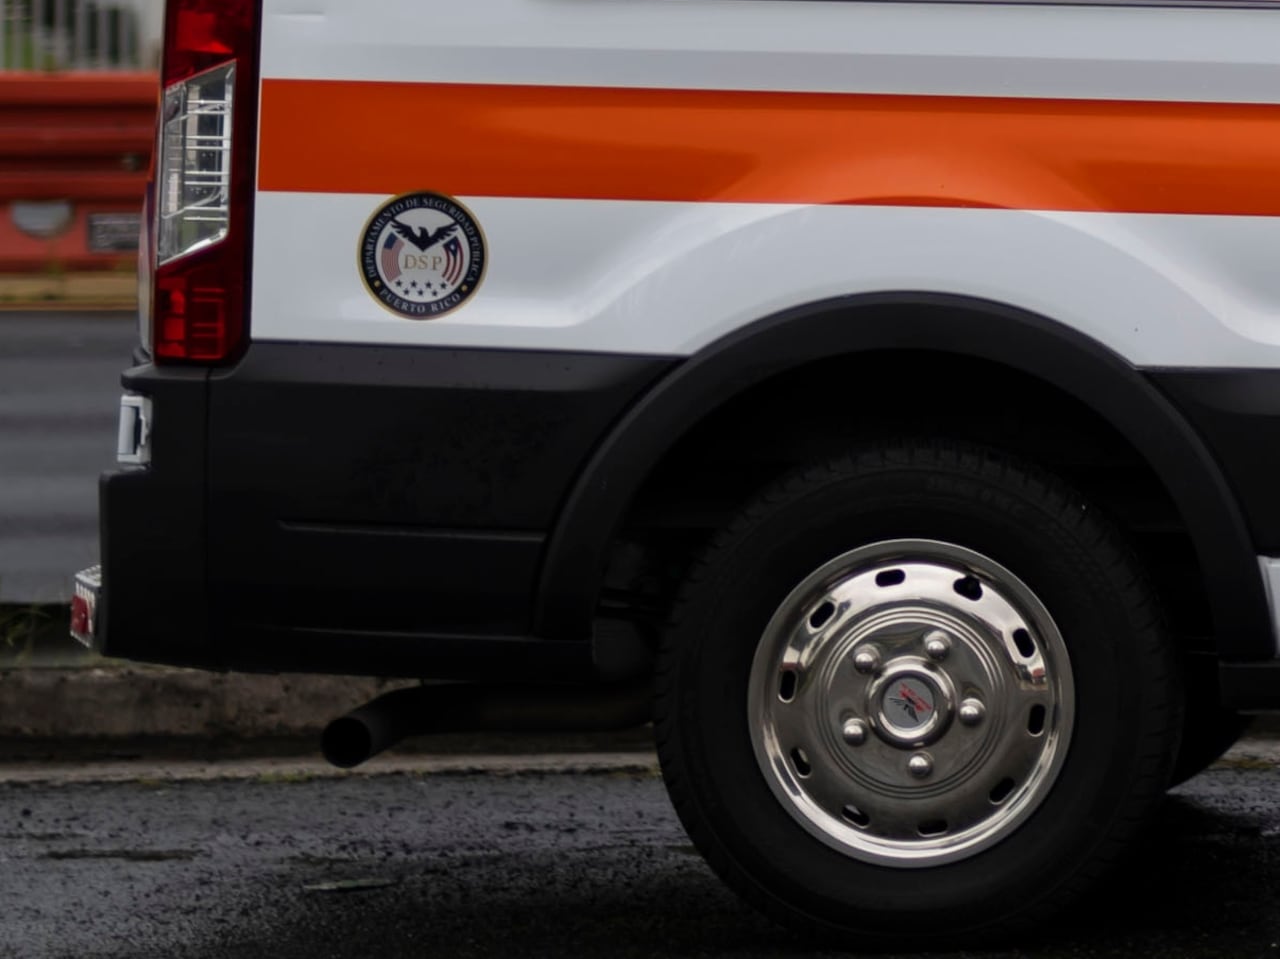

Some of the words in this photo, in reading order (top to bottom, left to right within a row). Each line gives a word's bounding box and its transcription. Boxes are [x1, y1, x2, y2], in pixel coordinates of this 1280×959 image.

[365, 202, 404, 278] DEPARTAMENTO
[406, 198, 421, 208] DE
[422, 198, 475, 235] SEGURIDAD
[404, 255, 442, 270] DSP
[380, 288, 425, 312] PUERTO
[431, 293, 460, 312] RICO
